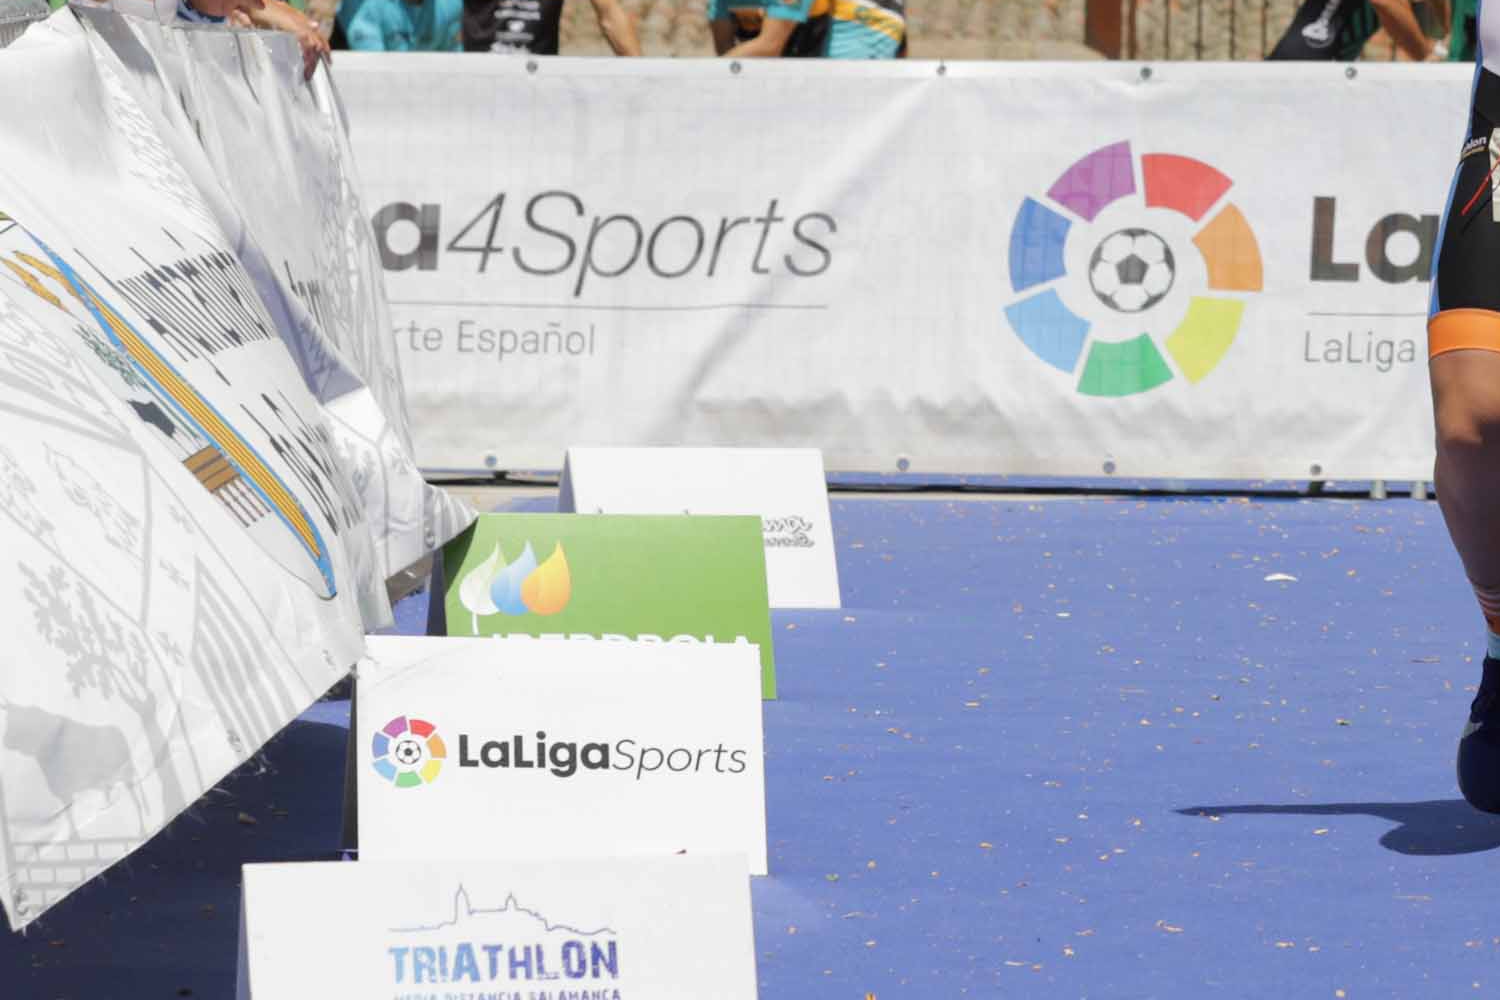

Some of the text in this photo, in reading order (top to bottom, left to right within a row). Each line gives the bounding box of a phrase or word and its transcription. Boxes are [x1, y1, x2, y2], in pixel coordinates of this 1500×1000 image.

[456, 319, 596, 363] Español
[1303, 330, 1417, 374] LaLiga
[457, 730, 747, 779] LaLigaSports
[388, 939, 620, 984] TRIATHLON
